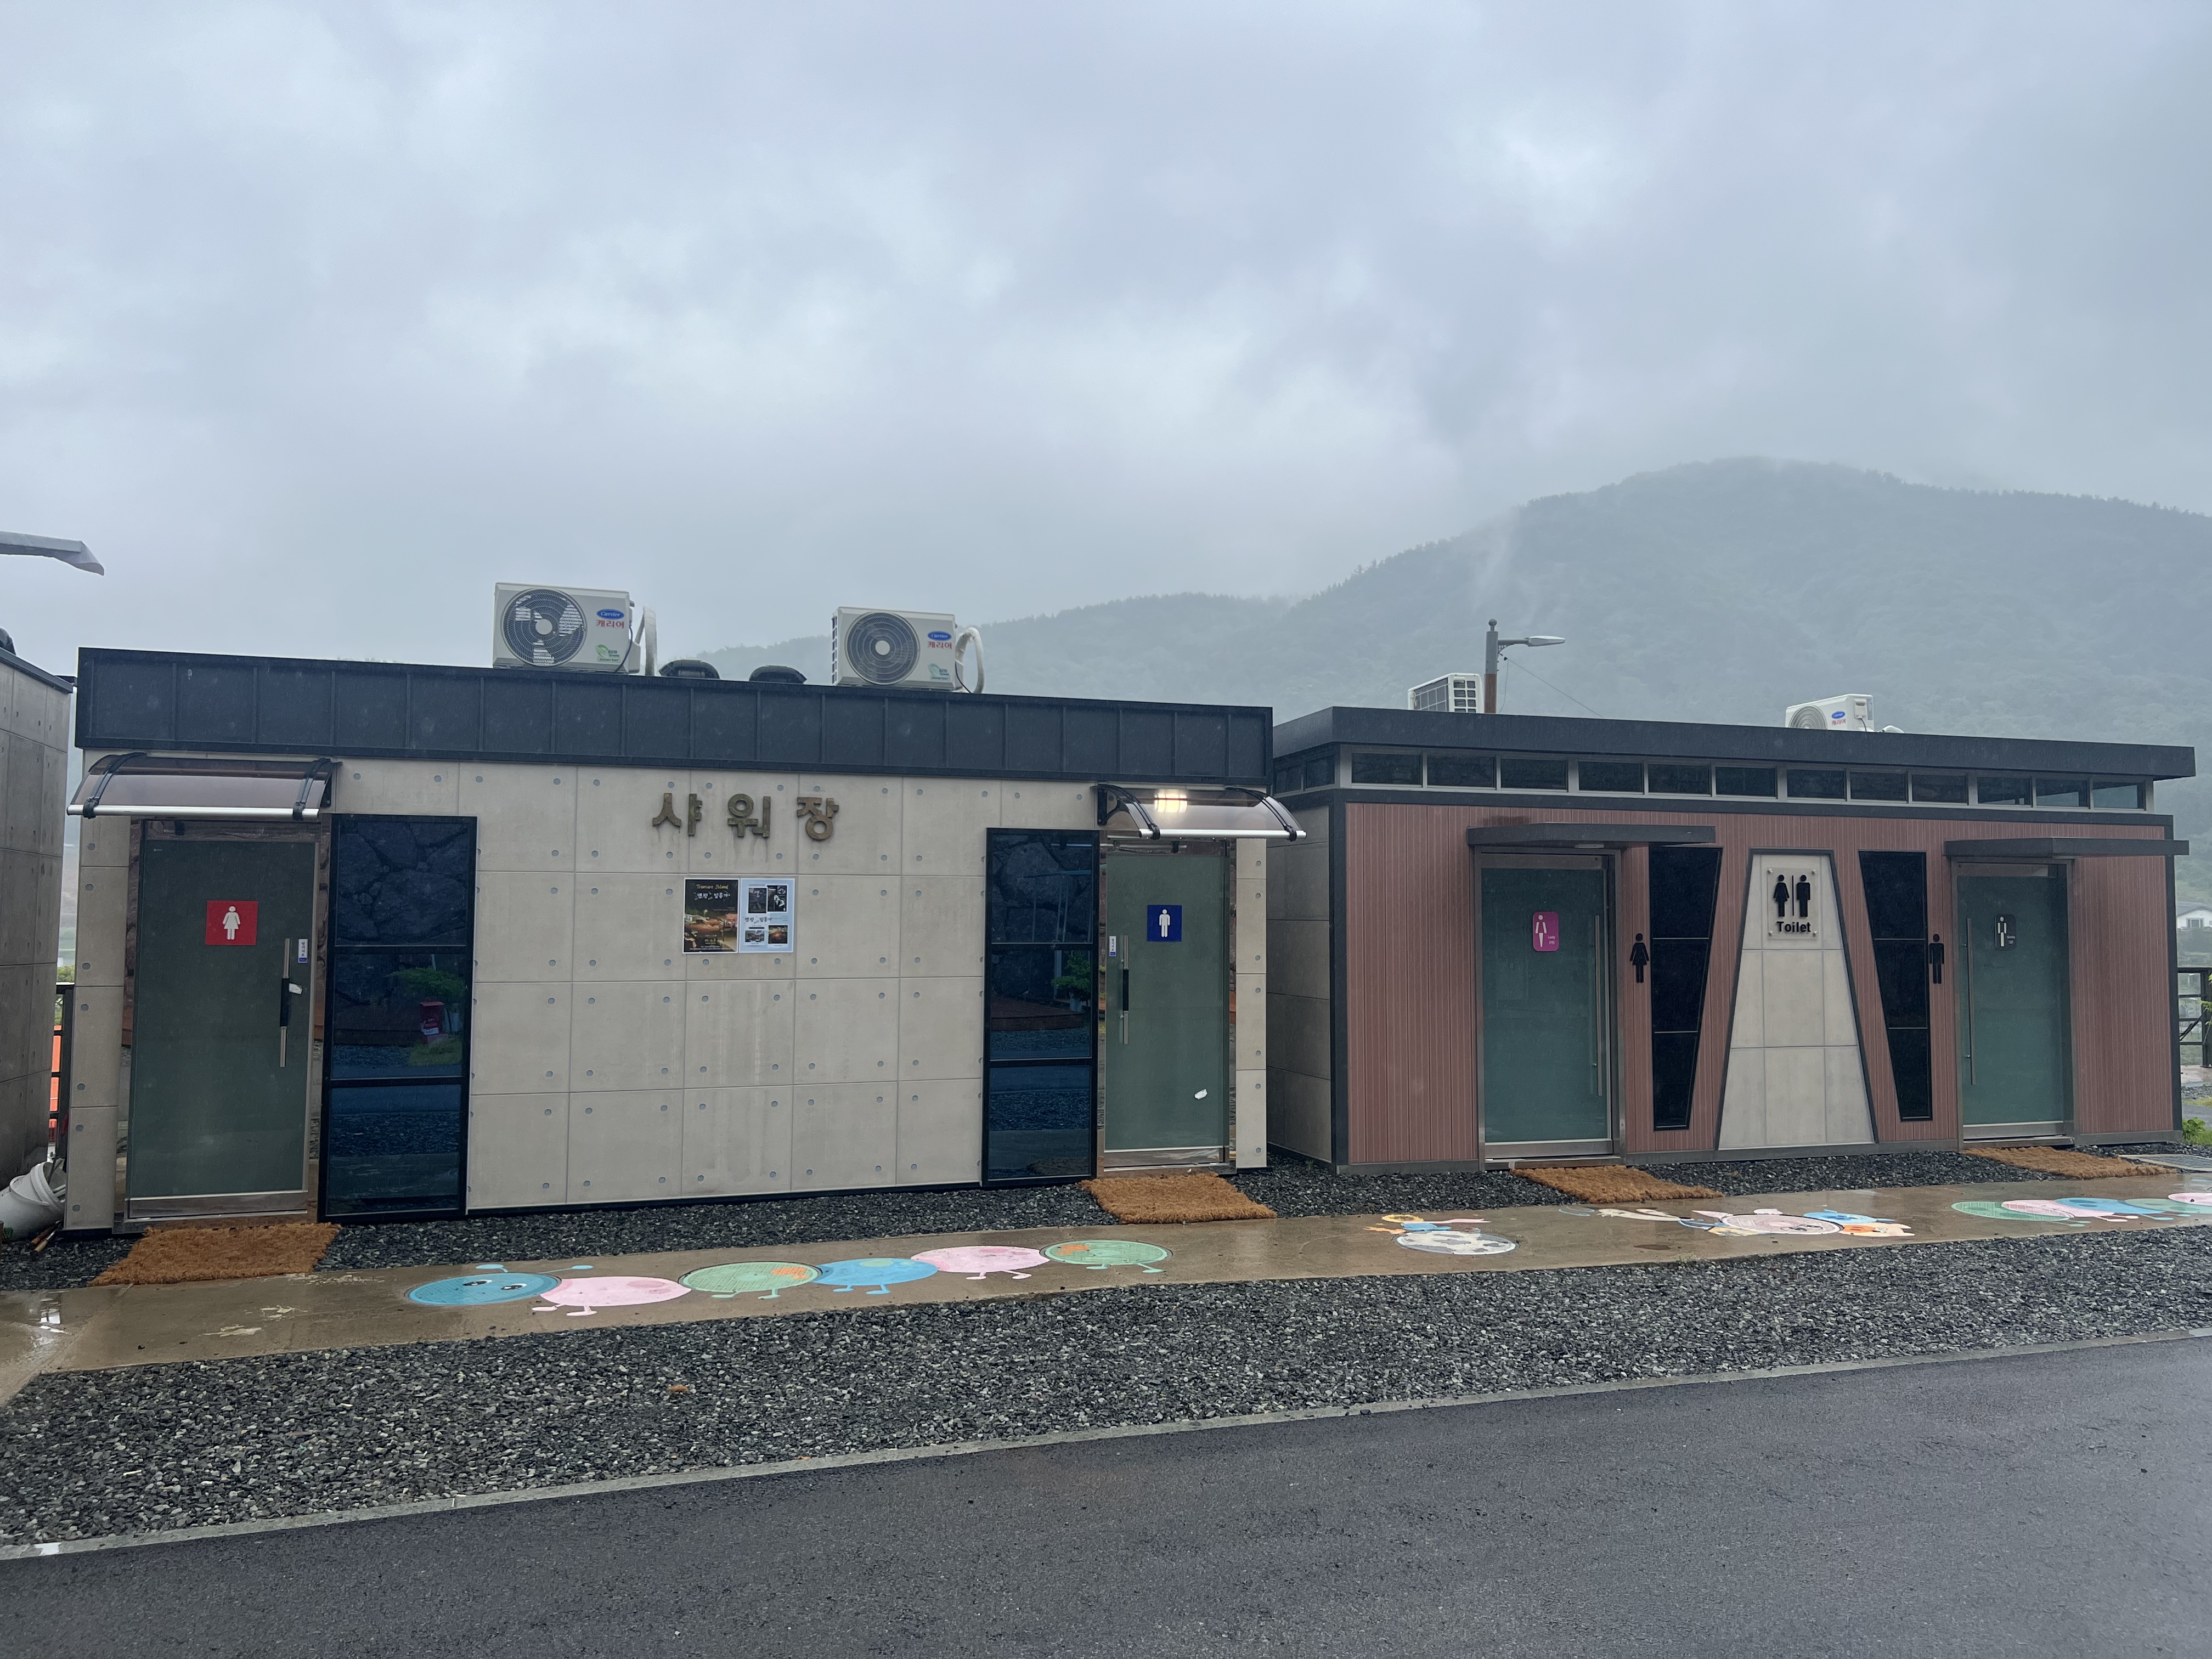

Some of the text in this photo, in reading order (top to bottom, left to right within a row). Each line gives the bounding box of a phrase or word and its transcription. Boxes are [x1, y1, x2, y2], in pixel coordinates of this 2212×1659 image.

[596, 619, 624, 629] 캐리어
[928, 641, 952, 650] 캐리어
[652, 793, 839, 840] 샤워장
[1776, 921, 1811, 933] Toilet
